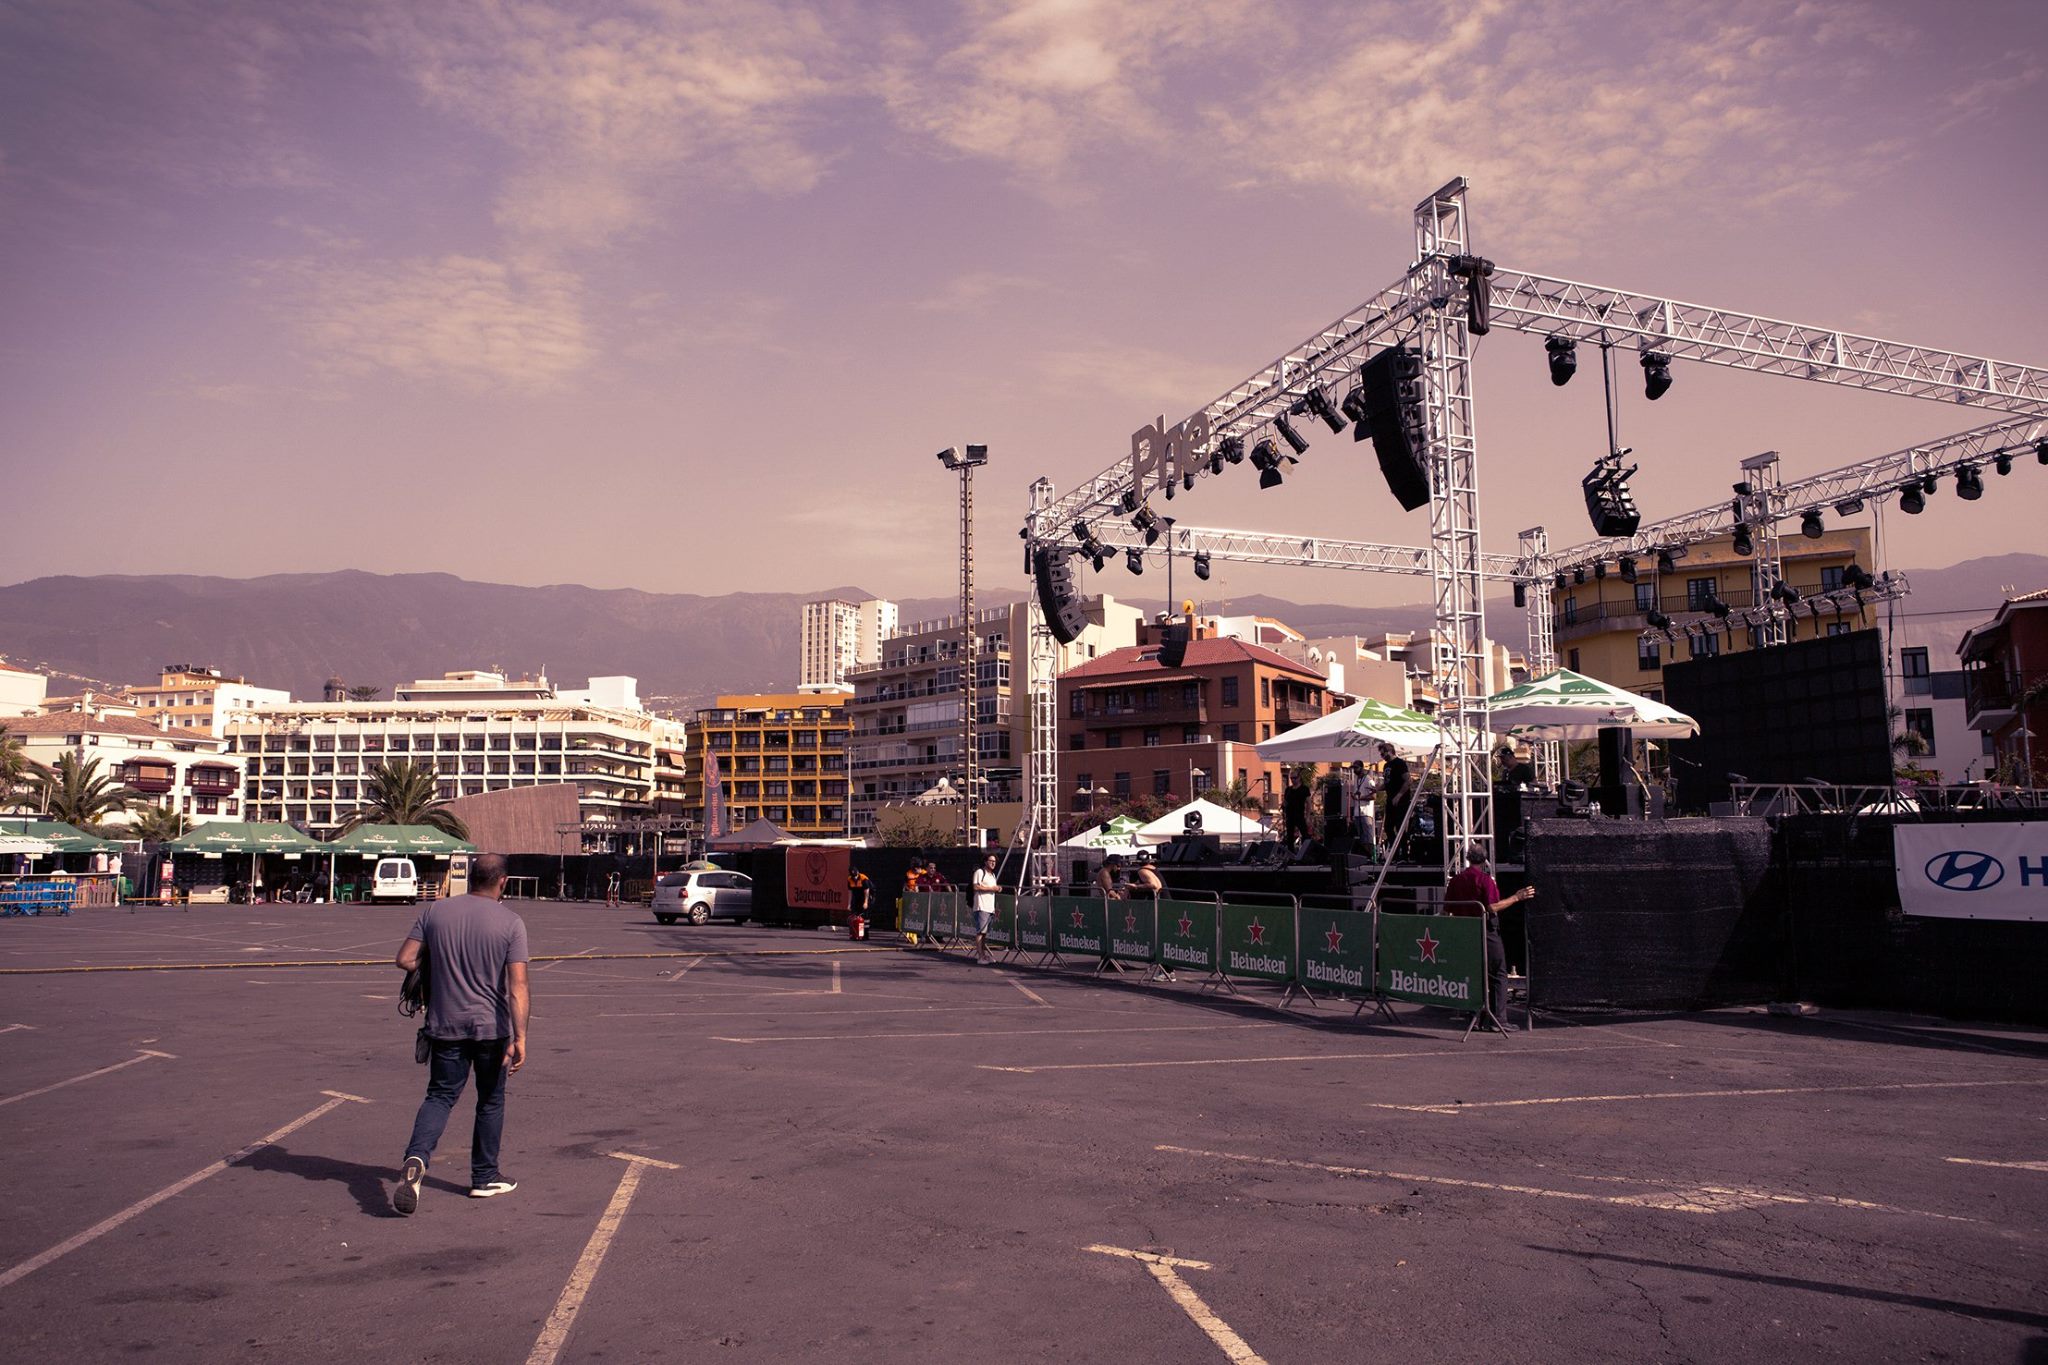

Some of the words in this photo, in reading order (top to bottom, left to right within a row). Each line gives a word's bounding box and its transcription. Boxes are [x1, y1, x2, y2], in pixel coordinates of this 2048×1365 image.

[1059, 933, 1101, 951] Heineken
[1113, 939, 1150, 957] Heineken
[1163, 943, 1209, 965] Heineken
[1230, 951, 1286, 975] Heineken
[1306, 959, 1363, 987] Heineken
[1390, 969, 1469, 1000] Heineken
